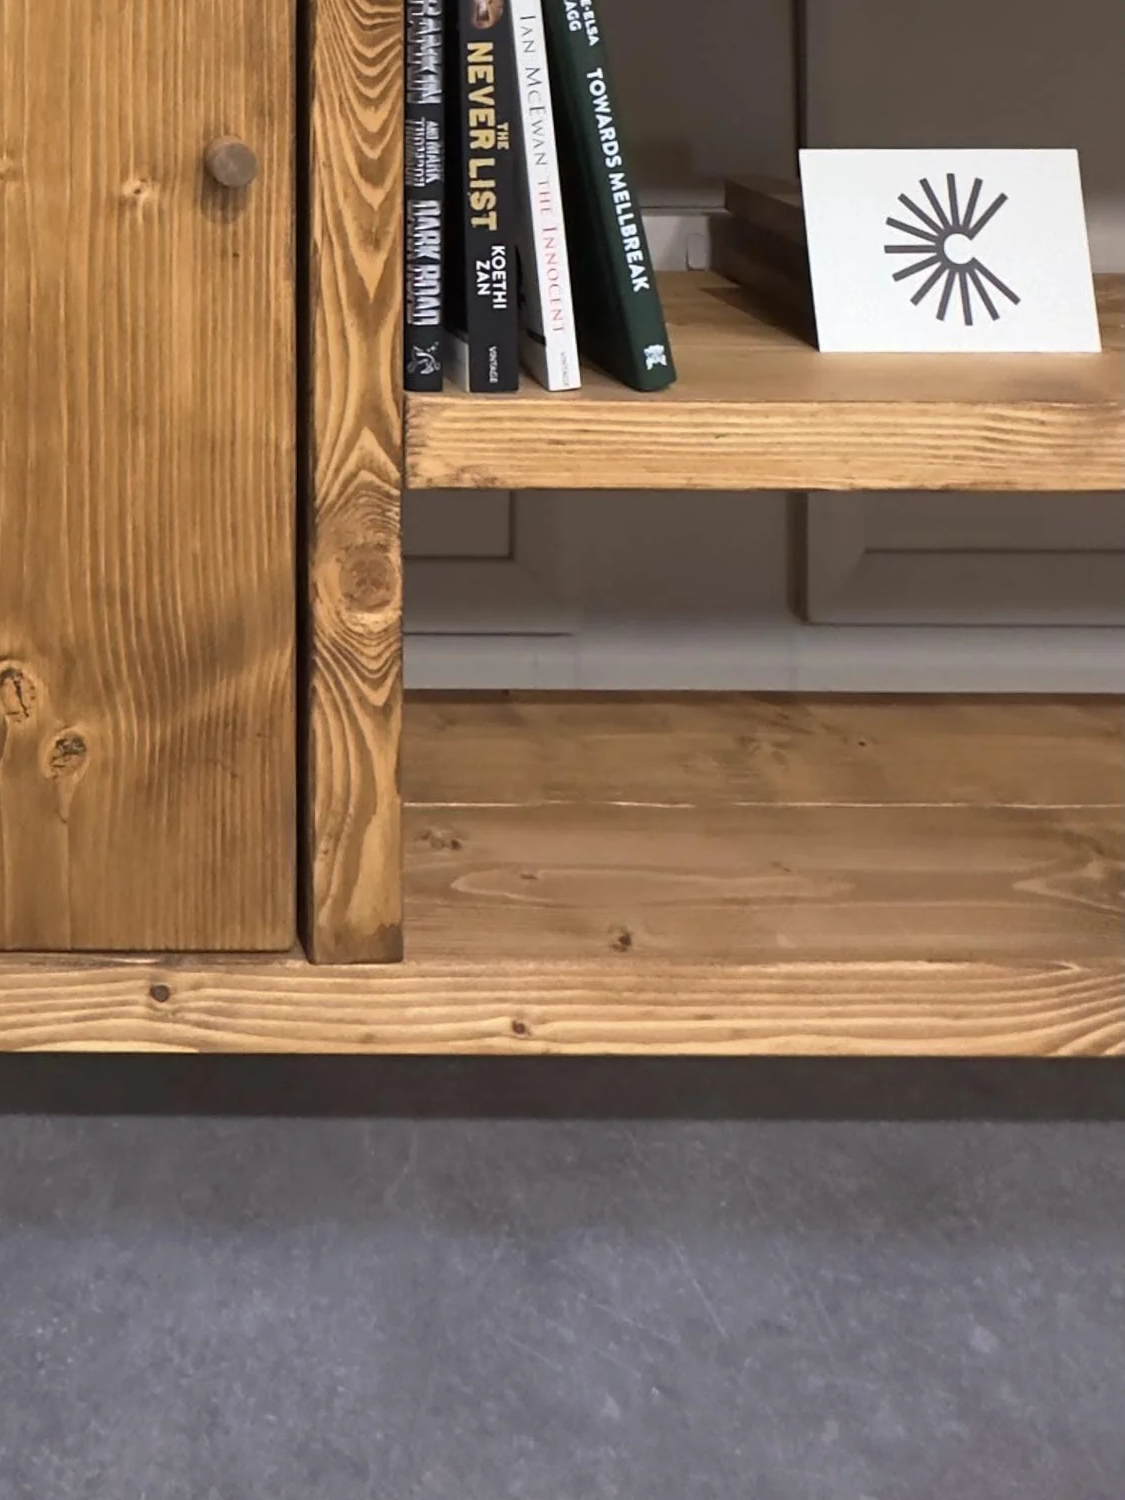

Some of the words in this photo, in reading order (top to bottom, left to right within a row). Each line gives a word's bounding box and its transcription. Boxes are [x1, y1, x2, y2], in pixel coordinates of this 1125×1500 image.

[520, 14, 537, 54] IAN
[467, 41, 496, 150] NEVER
[496, 121, 510, 150] THE
[468, 158, 498, 232] LIST
[537, 176, 552, 212] THE
[586, 67, 622, 168] TOWARDS
[608, 172, 651, 293] MELLBREAK
[409, 200, 441, 258] DARK
[475, 259, 491, 296] ZAN
[491, 245, 507, 310] KOETHI
[542, 226, 566, 332] INNOCENT
